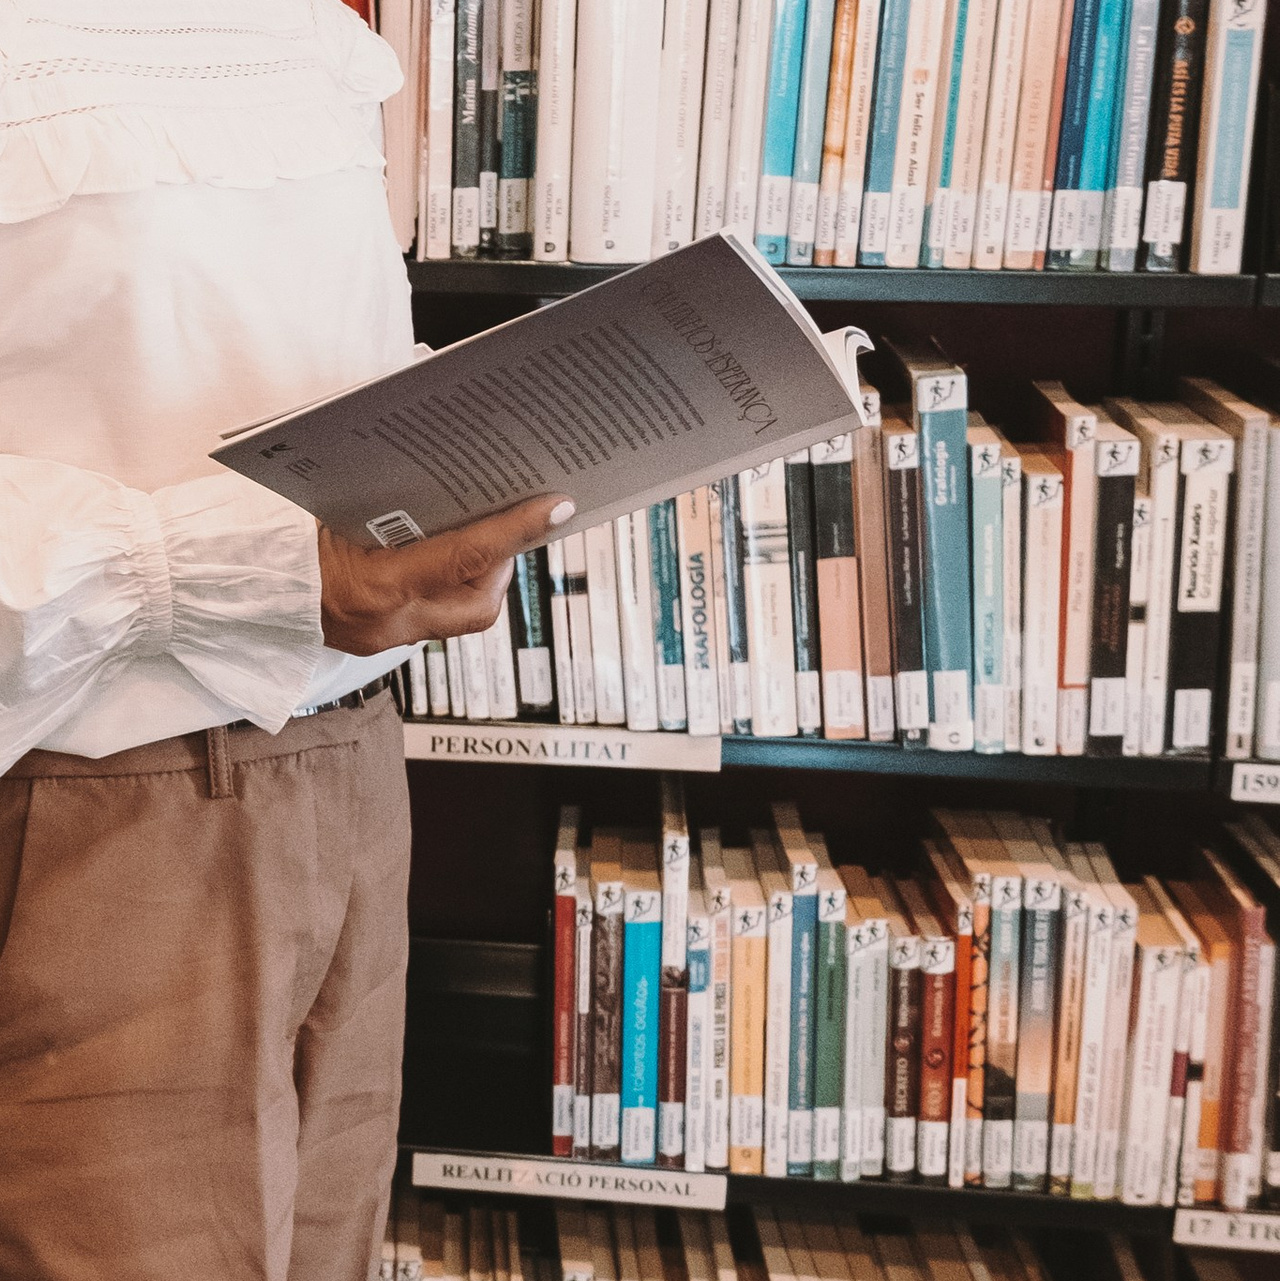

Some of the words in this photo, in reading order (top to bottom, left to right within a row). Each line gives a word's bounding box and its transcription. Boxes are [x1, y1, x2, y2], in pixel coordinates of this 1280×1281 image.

[463, 3, 479, 64] Anatomía
[1172, 59, 1189, 81] ASÍ
[461, 79, 477, 125] Marina
[914, 92, 926, 111] Ser
[1170, 97, 1185, 112] LA
[1171, 81, 1187, 97] ES
[911, 114, 924, 138] feliz
[1166, 113, 1184, 146] PUTA
[910, 141, 919, 155] en
[1162, 147, 1180, 177] VIDA
[705, 346, 780, 437] ESPERANÇA
[932, 440, 950, 508] Grafología
[1185, 548, 1202, 601] Mauricio
[429, 735, 633, 762] PERSONALITAT
[635, 974, 650, 1029] ocultos
[632, 1031, 647, 1091] talentos
[893, 1055, 908, 1114] SECRETO
[440, 1162, 582, 1189] REALITZACIÓ
[587, 1174, 696, 1199] PERSONAL
[1188, 1218, 1212, 1236] 17
